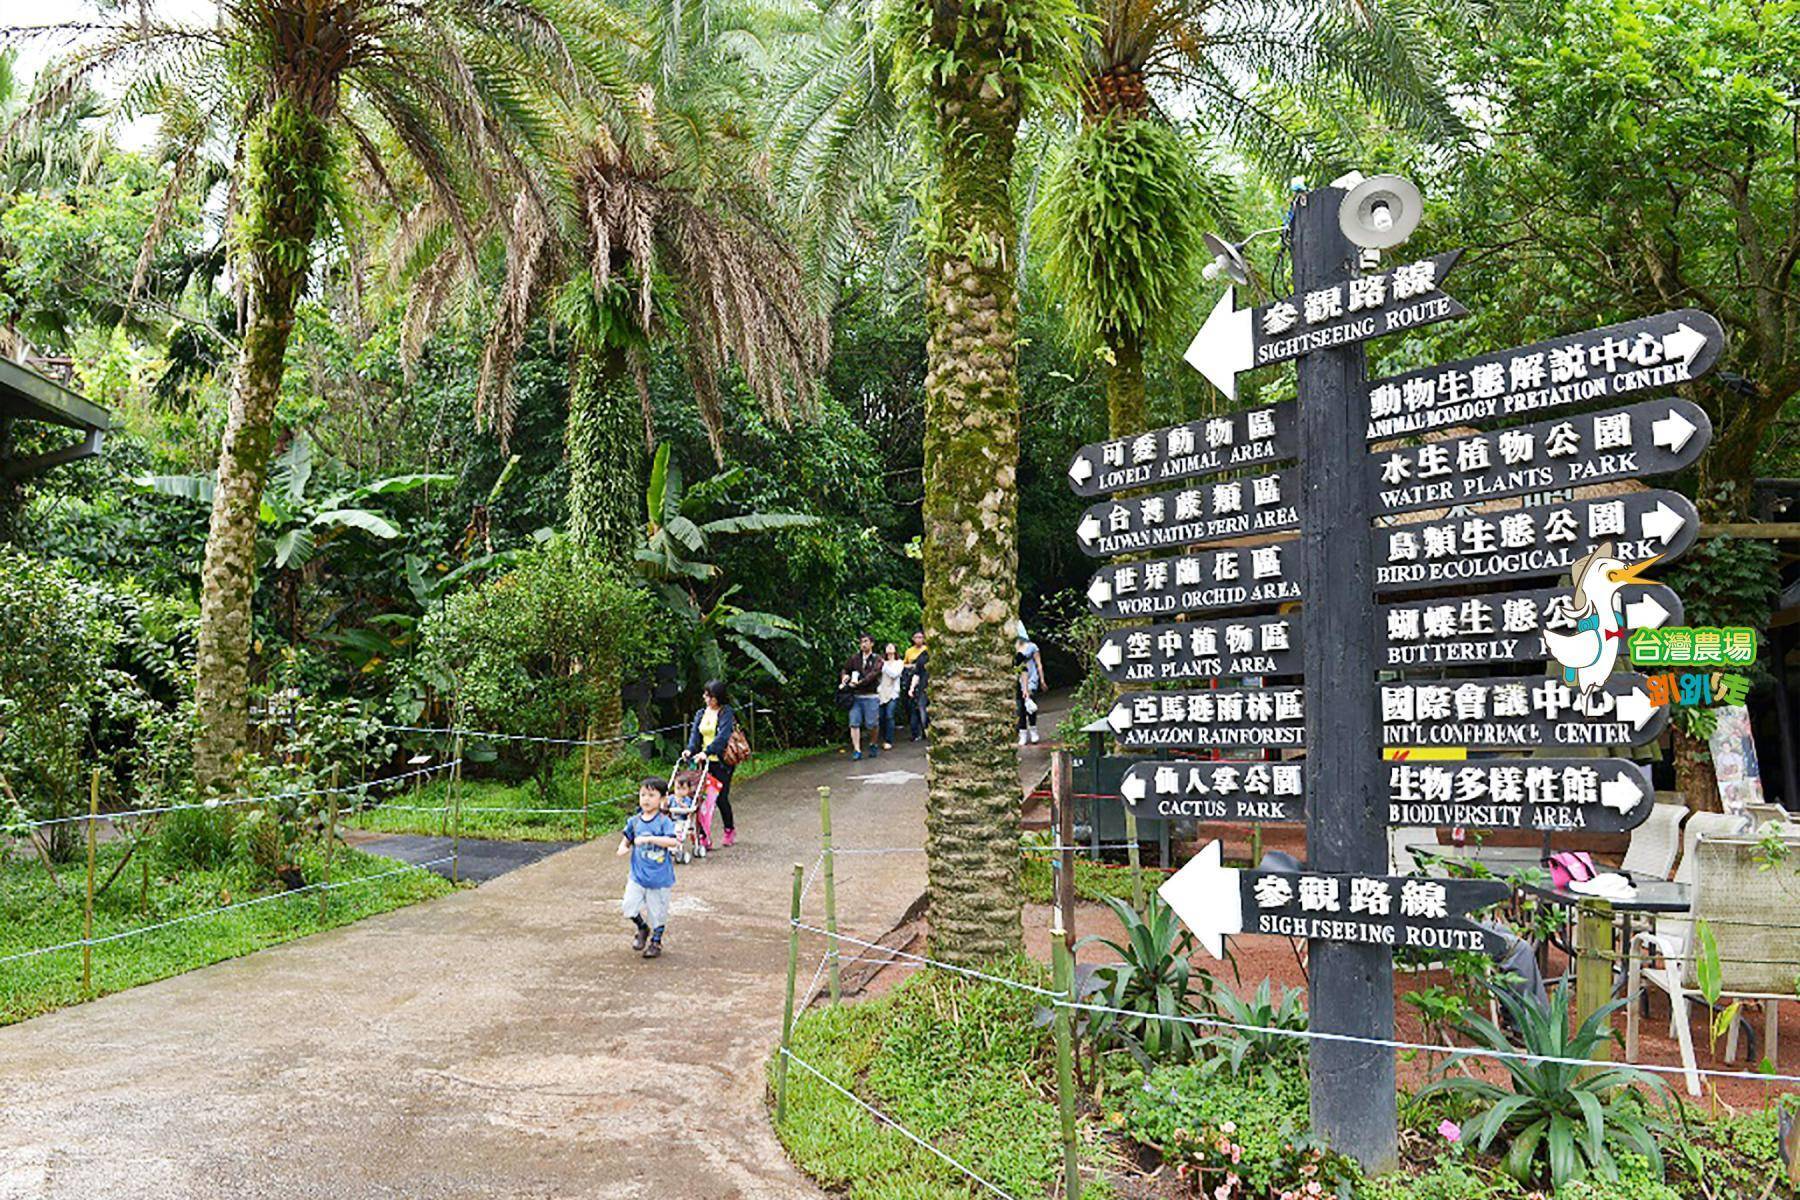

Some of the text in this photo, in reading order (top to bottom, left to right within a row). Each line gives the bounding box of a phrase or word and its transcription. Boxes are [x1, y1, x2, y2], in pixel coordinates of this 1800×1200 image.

[1258, 297, 1451, 363] SIGHTSEEING ROUTE
[1366, 362, 1692, 438] ANIMAL ECOLOGY PRETATION CENTER
[1099, 441, 1275, 489] LOVELY ANIMAL AREA
[1380, 412, 1633, 484] 水生植物公園
[1380, 480, 1453, 509] WATER
[1463, 467, 1553, 496] PLANTS
[1569, 452, 1638, 481] PARK
[1098, 506, 1299, 553] TAIWAN NATIVE FERN AREA
[1387, 501, 1626, 562] 鳥類生態公園
[1377, 563, 1425, 584] BIRD
[1429, 550, 1574, 579] ECOLOGICAL
[1117, 582, 1301, 615] WORLD ORCHID AREA
[1387, 591, 1621, 640] 蝴蝶生態公
[1126, 621, 1290, 659] 空中植物區
[1388, 639, 1517, 664] BUTTERFLY
[1126, 656, 1277, 680] AIR PLANTS AREA
[1382, 680, 1616, 722] 國際會議中心
[1125, 727, 1306, 745] AMAZON RAINFOREST
[1383, 722, 1631, 744] INT'L CONFERENCE CENTER
[1389, 765, 1599, 802] 生物多樣性館
[1158, 800, 1286, 818] CACTUS PARK
[1389, 804, 1586, 827] BIODIVERSITY AREA
[1259, 915, 1485, 950] SIGHTSEEING ROUTE
